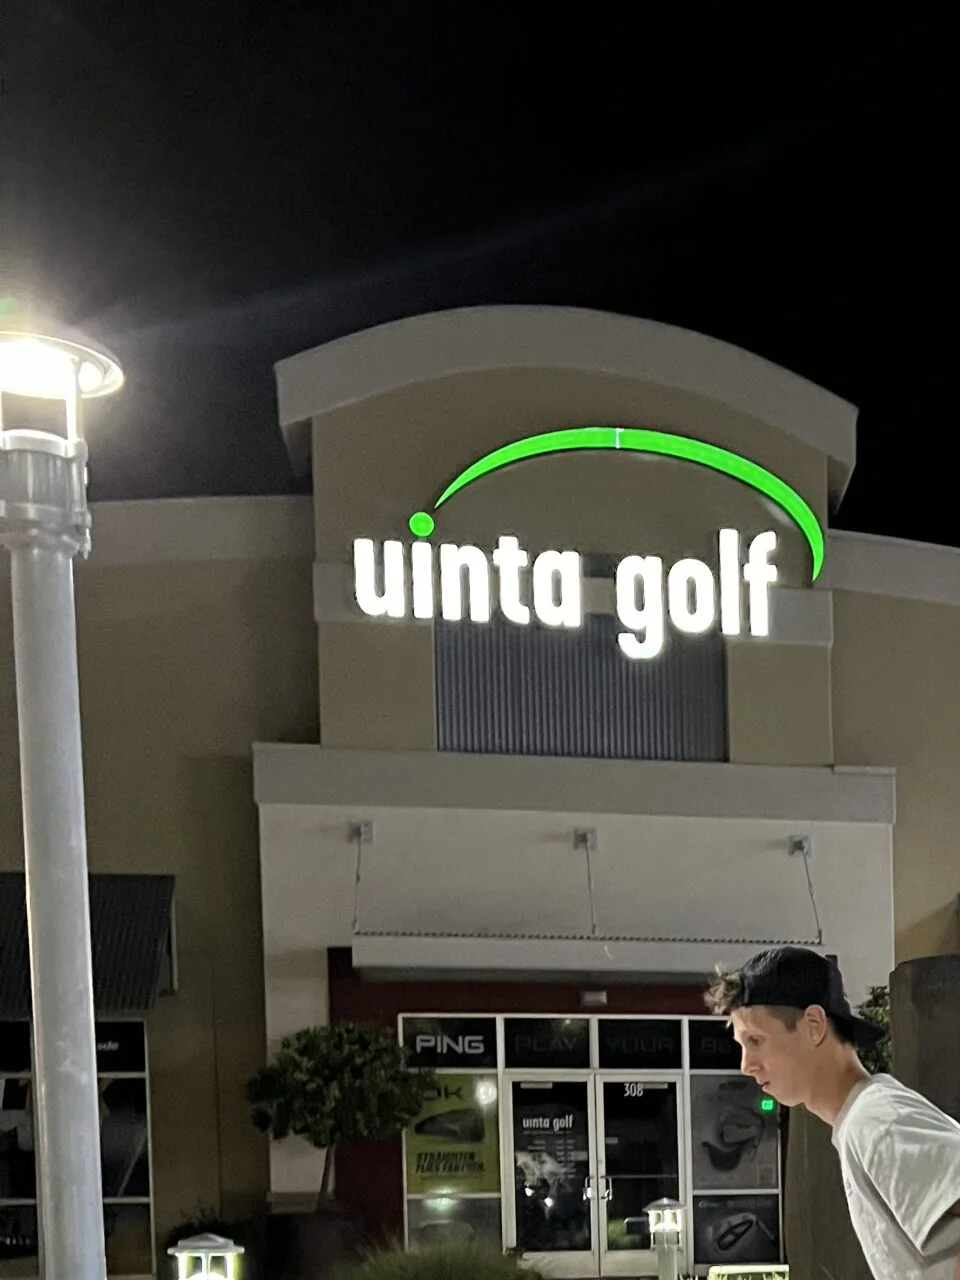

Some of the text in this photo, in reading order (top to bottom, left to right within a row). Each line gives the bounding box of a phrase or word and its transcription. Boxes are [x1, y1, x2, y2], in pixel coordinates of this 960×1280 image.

[354, 511, 778, 659] uinta golf
[415, 1034, 485, 1054] PING
[623, 1082, 644, 1097] 308
[522, 1113, 574, 1132] uinta golf
